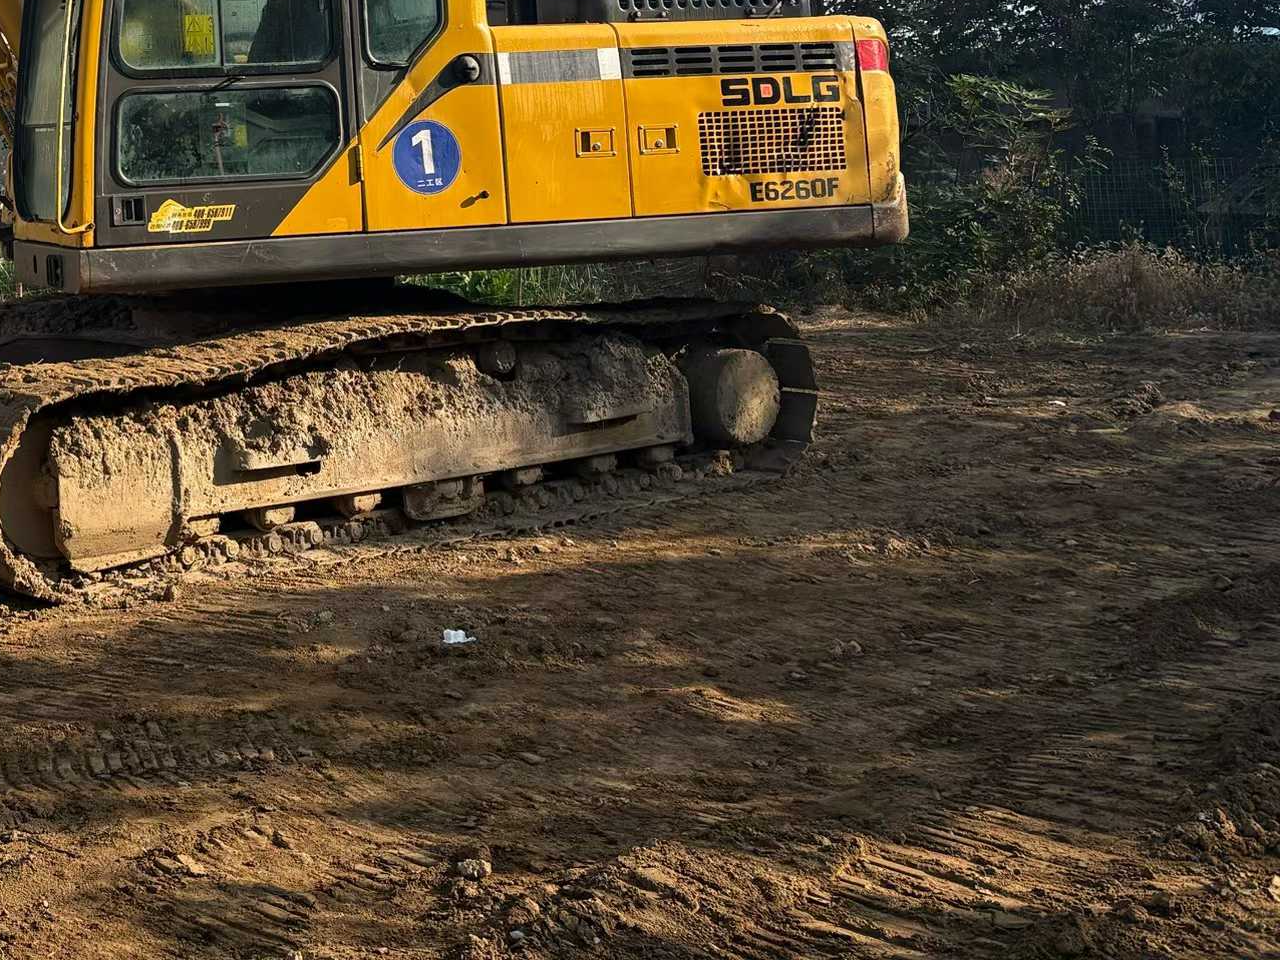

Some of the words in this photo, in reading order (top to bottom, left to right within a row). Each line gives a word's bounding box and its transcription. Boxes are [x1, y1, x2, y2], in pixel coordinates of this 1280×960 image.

[720, 75, 840, 106] SDLG
[411, 129, 435, 174] 1
[749, 177, 840, 202] E6260F
